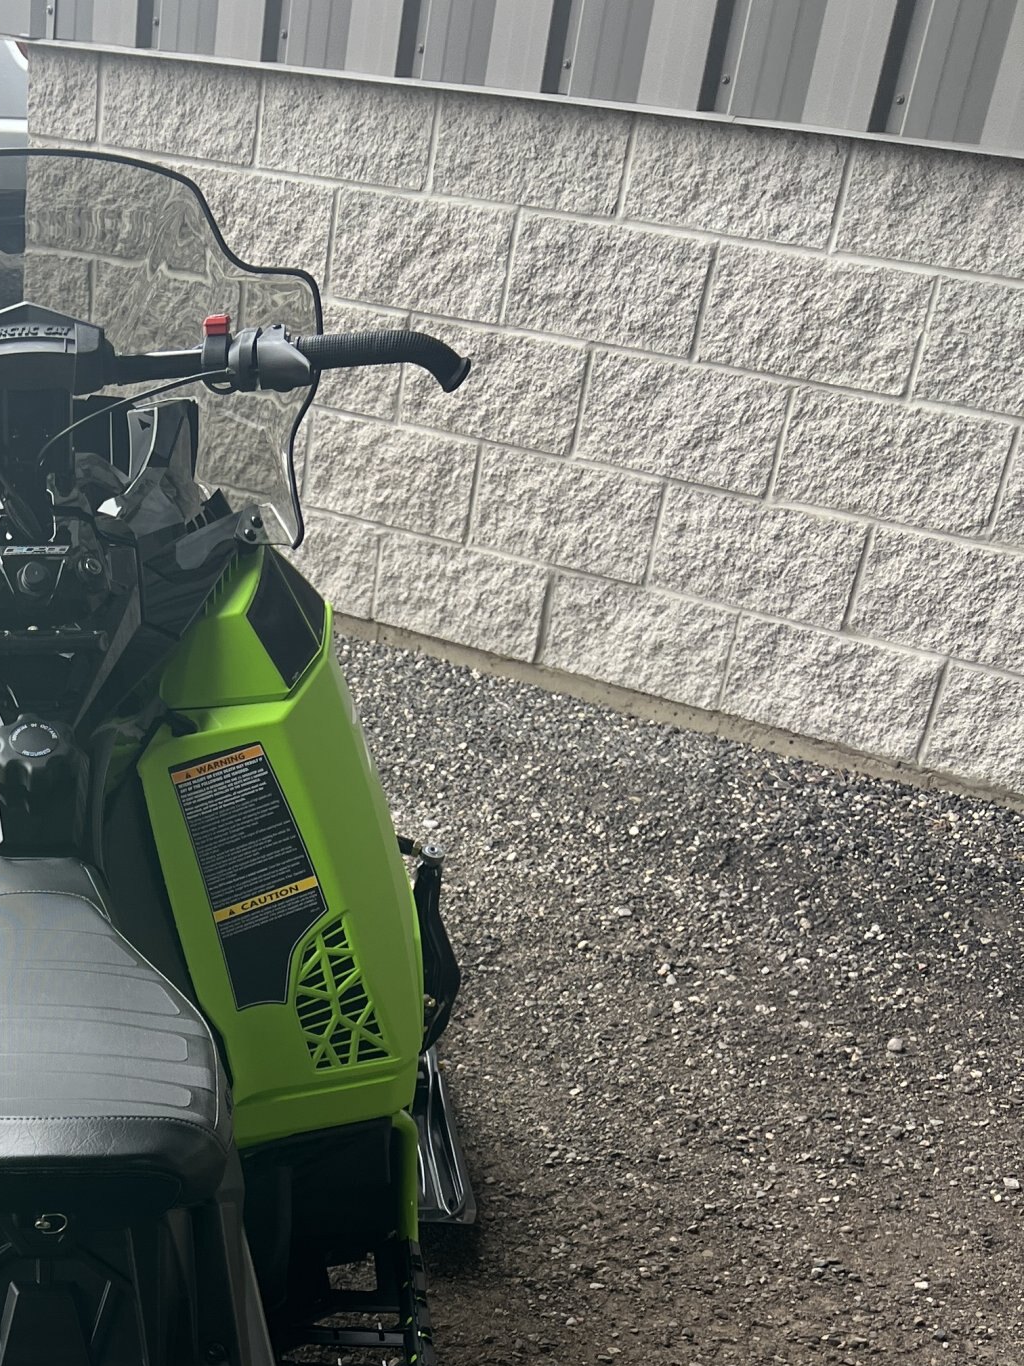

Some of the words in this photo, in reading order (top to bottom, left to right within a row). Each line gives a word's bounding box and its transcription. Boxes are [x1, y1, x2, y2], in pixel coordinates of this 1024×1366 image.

[44, 326, 71, 337] CAT
[196, 752, 246, 774] WARNING
[240, 884, 299, 911] CAUTION
